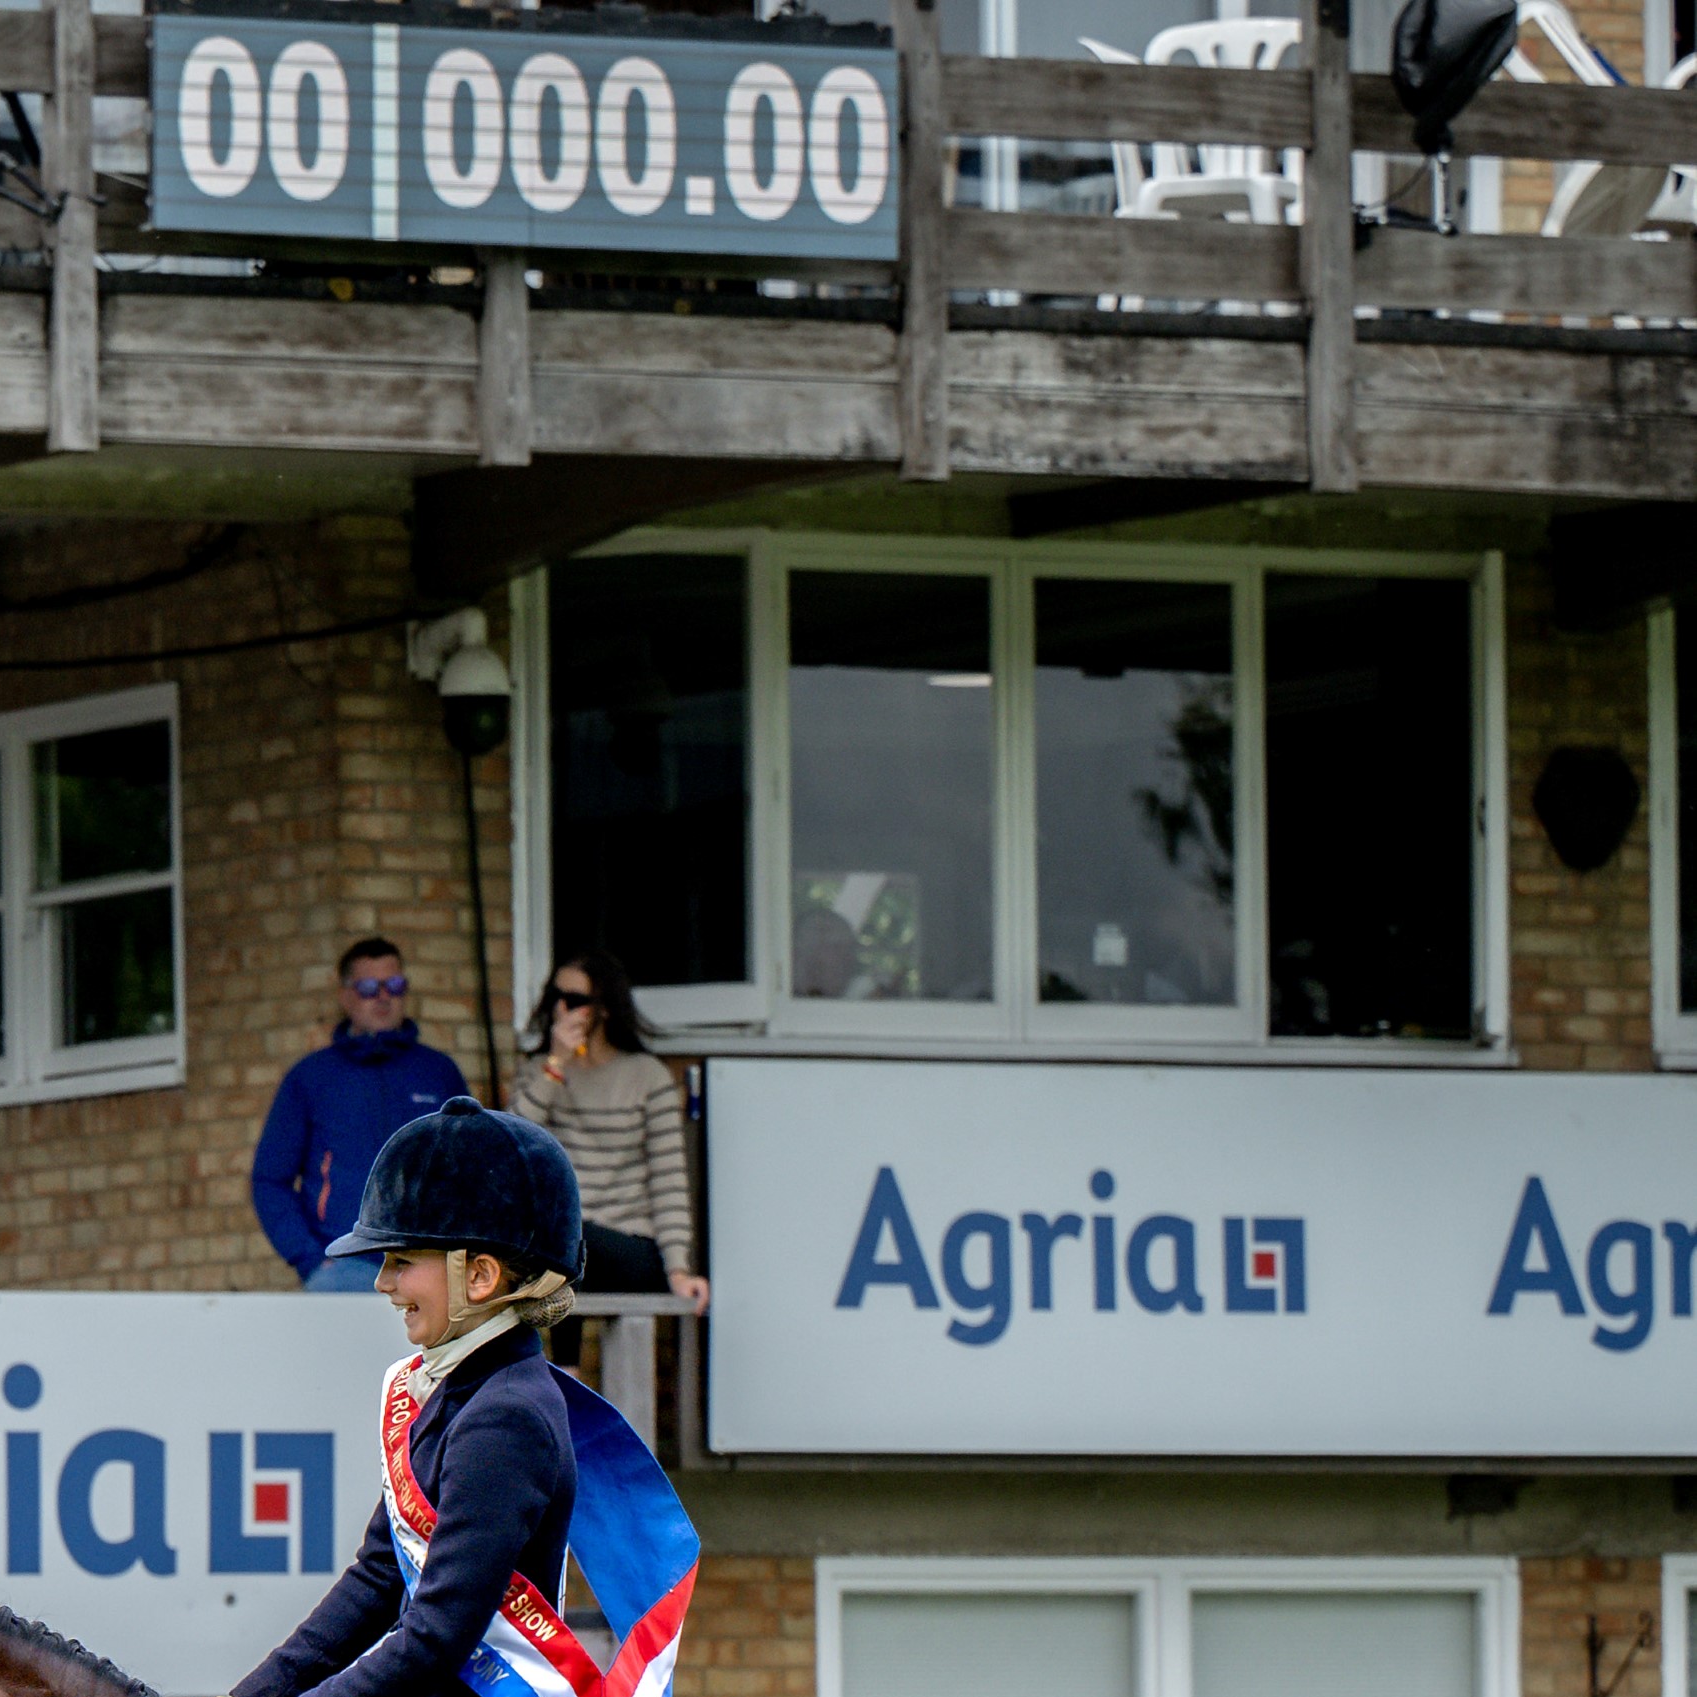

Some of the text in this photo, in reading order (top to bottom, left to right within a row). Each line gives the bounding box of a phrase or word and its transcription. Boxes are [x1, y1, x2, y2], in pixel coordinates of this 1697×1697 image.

[177, 35, 890, 225] 00 000.00
[834, 1164, 1205, 1347] Agria
[1485, 1174, 1697, 1354] Agr
[391, 1444, 436, 1537] INTERNATIO
[509, 1593, 558, 1642] SHOW
[469, 1647, 510, 1686] PONY
